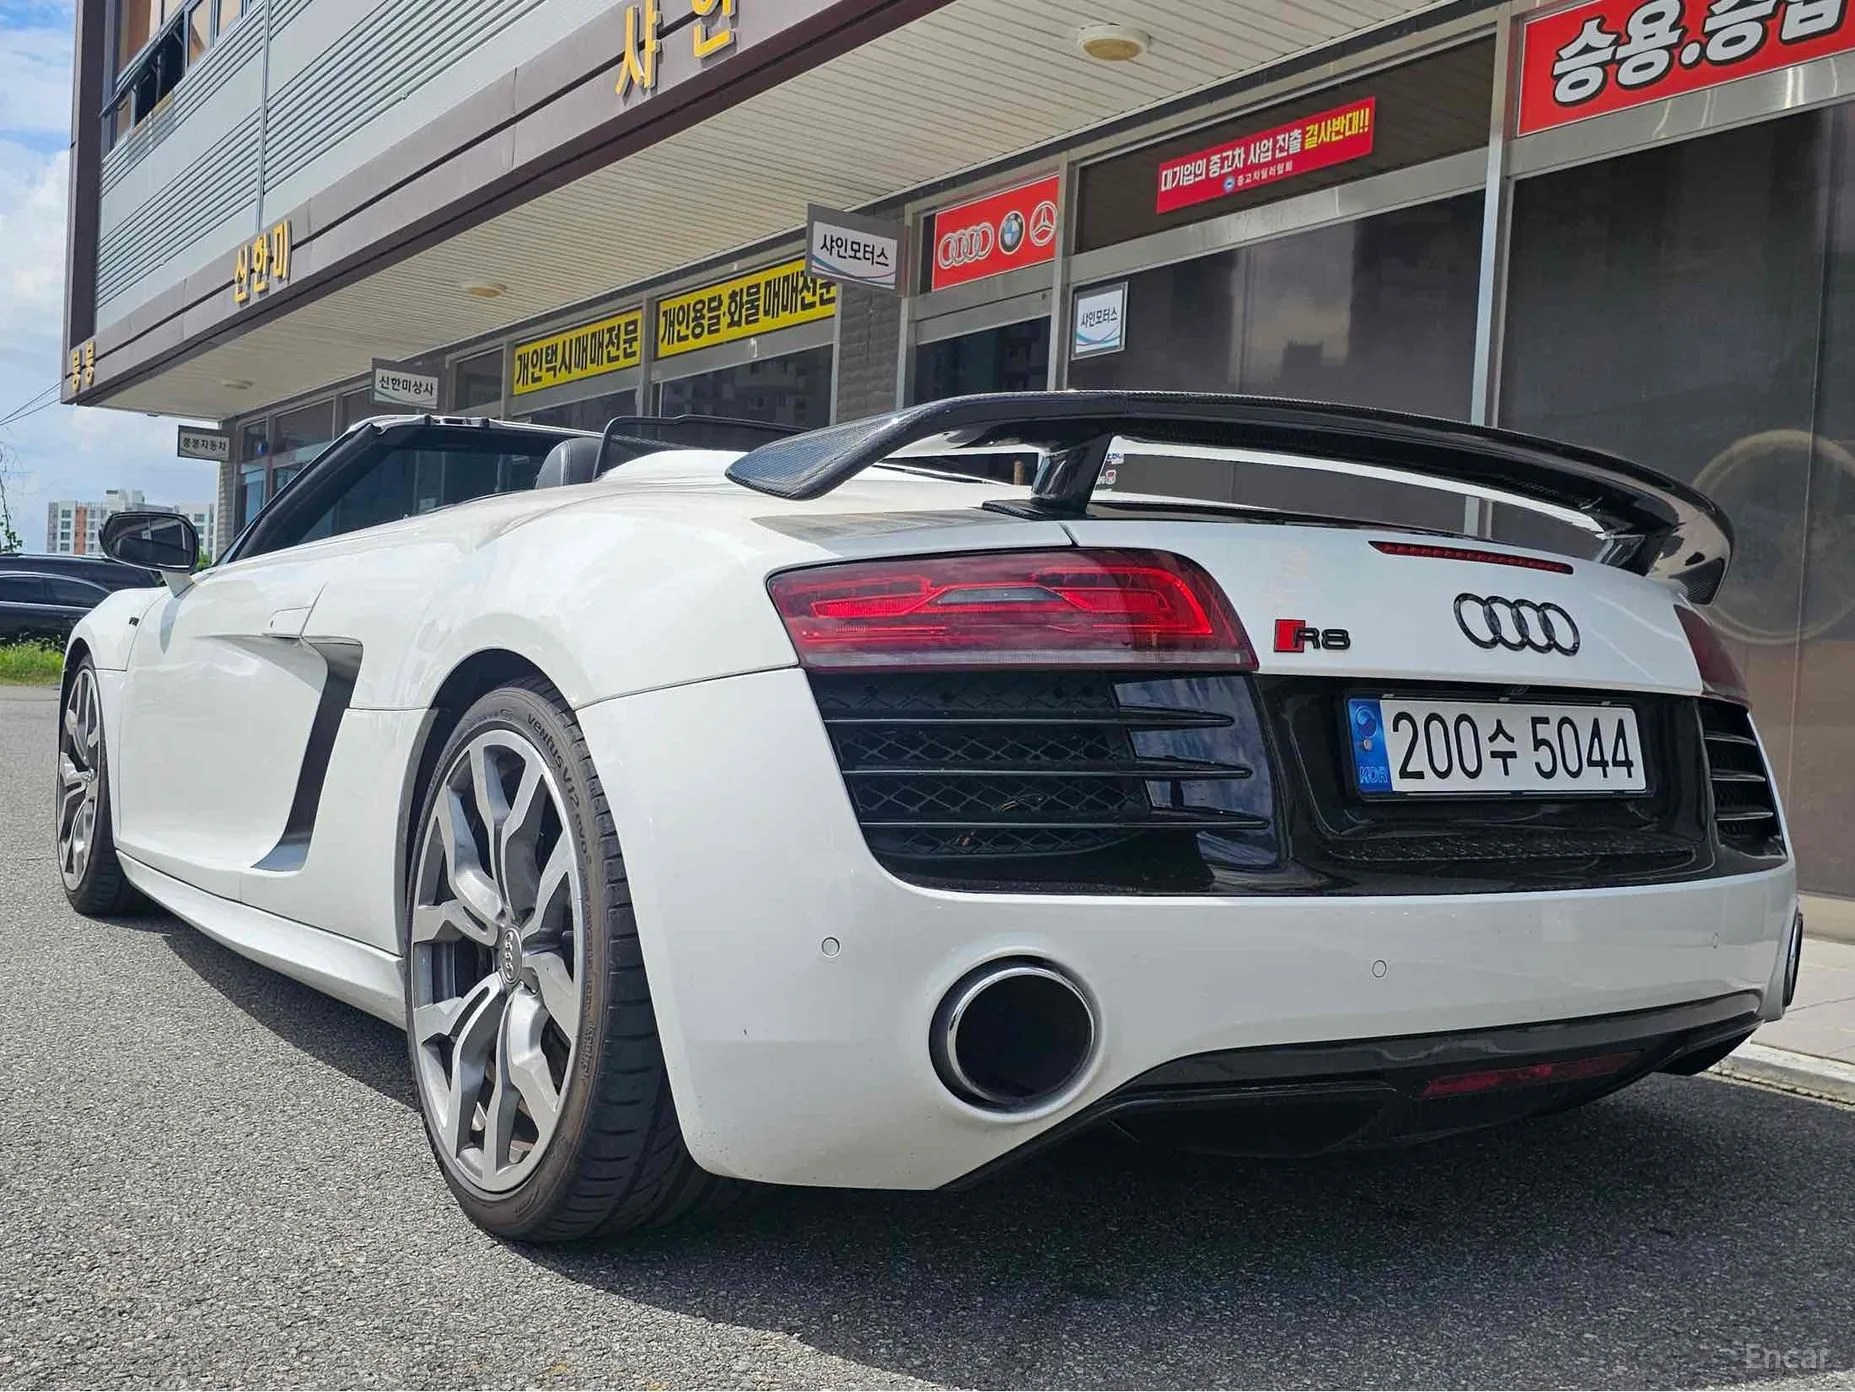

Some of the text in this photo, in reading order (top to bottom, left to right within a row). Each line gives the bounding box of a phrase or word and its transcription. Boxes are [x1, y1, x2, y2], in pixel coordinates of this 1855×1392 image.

[1161, 107, 1370, 192] 대기업의 중고차 사업 진출 결사반대!!
[234, 218, 291, 302] 신한미
[820, 233, 889, 267] 샤인모터스
[1080, 306, 1118, 328] 샤인모터스
[515, 318, 639, 387] 개인택시매매전문
[379, 375, 434, 396] 신한미상사
[1295, 627, 1351, 650] R8
[1391, 710, 1634, 780] 200수 5044
